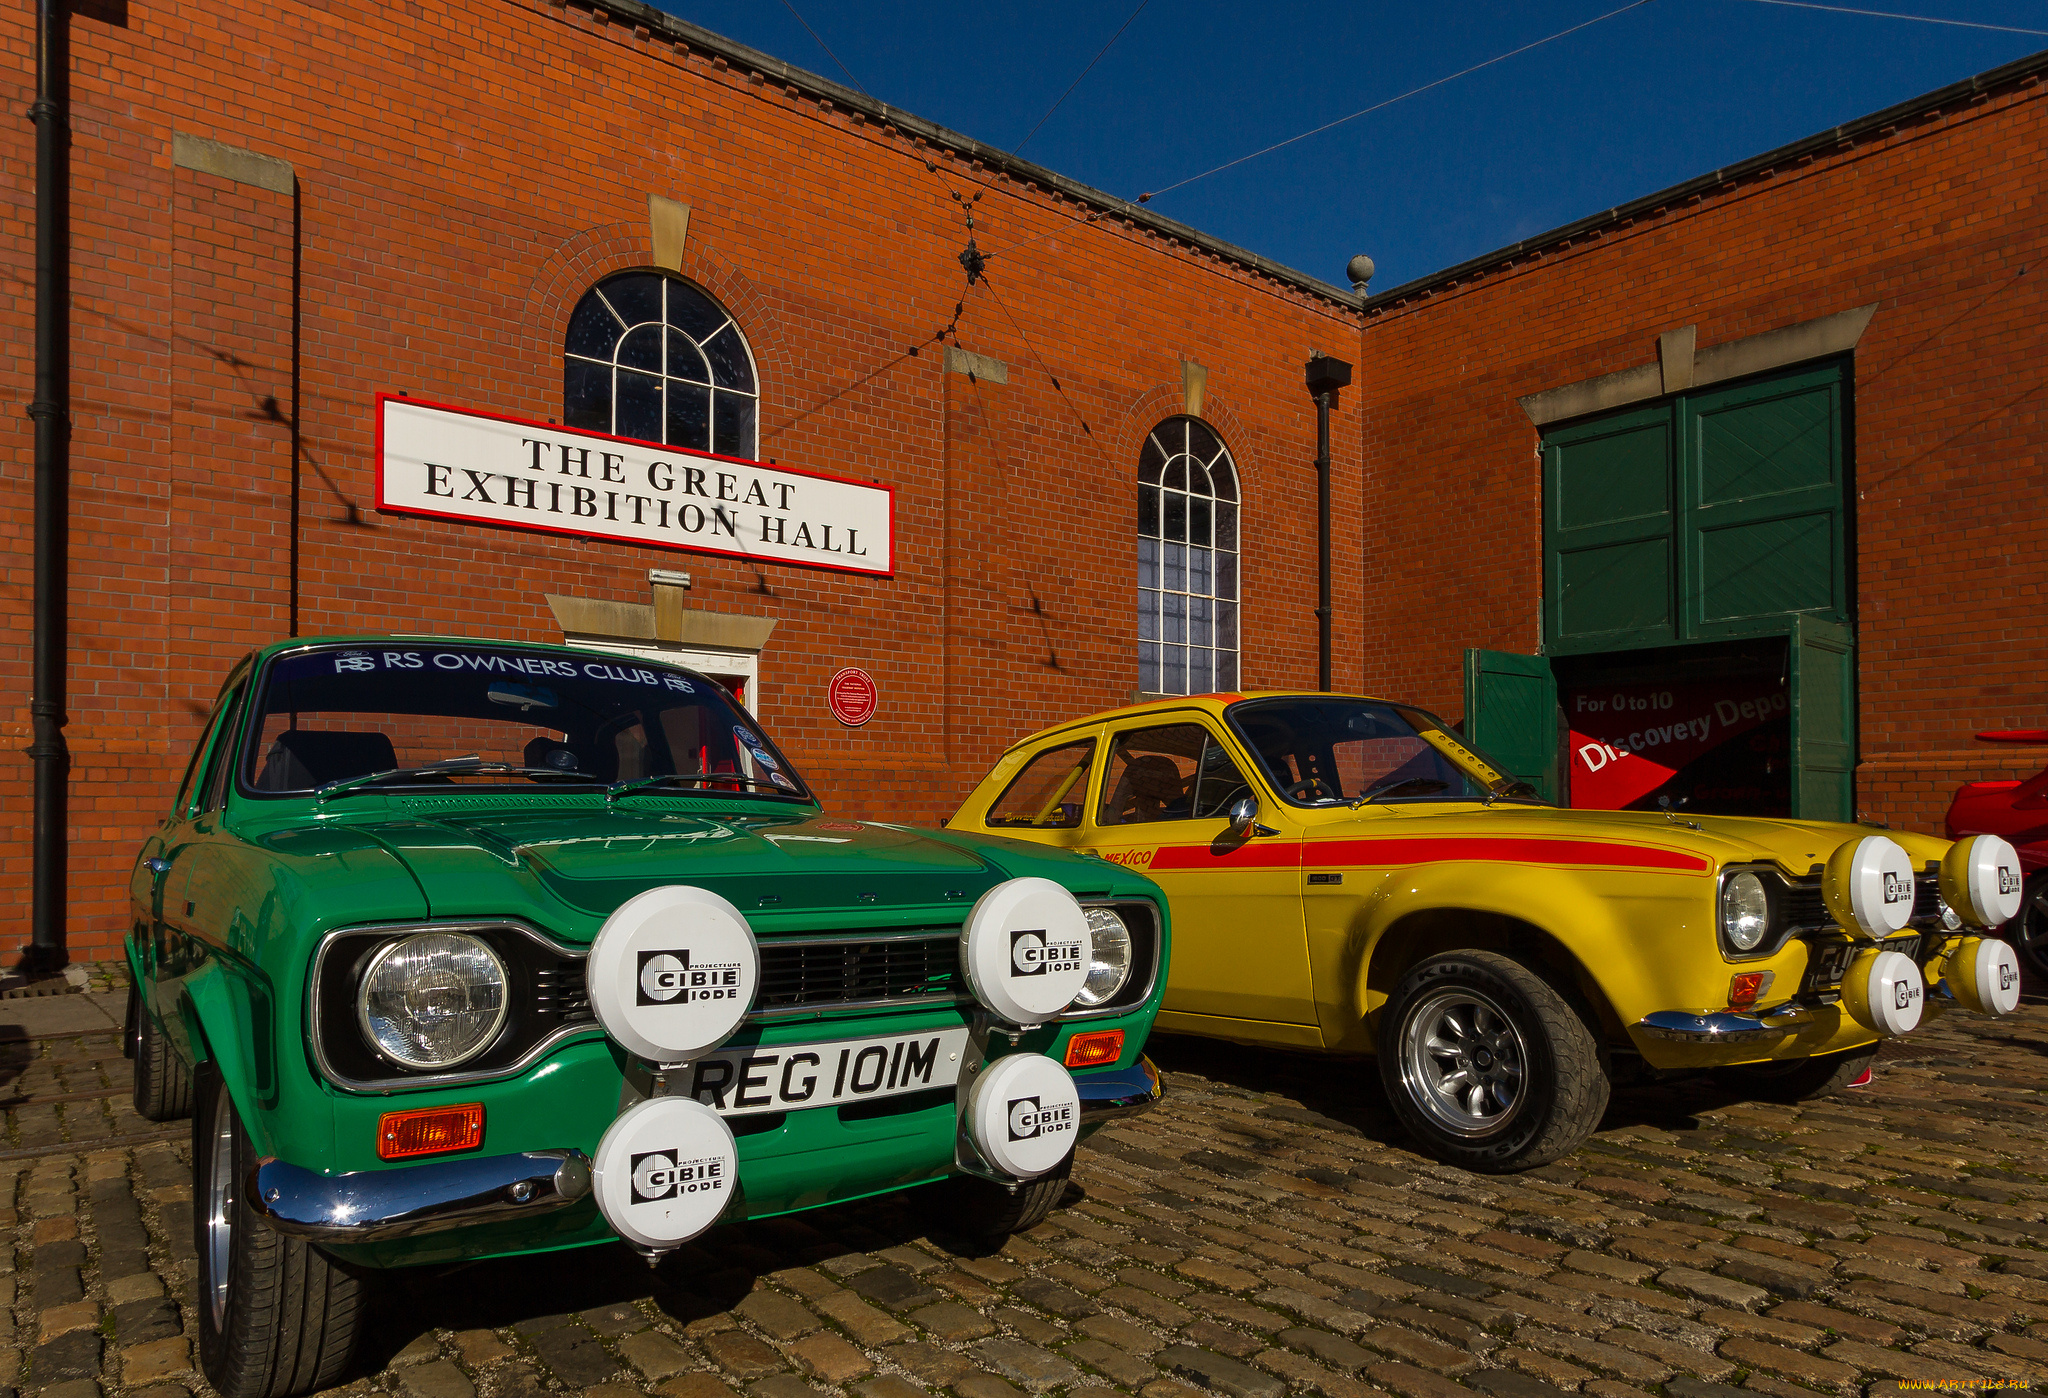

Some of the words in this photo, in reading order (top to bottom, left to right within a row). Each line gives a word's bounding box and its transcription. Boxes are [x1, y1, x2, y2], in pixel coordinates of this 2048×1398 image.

[522, 438, 626, 484] THE
[646, 461, 796, 511] GREAT
[423, 462, 738, 539] EXHIBITION
[759, 514, 868, 557] HALL
[383, 652, 424, 670] RS
[433, 653, 578, 678] OWNERS
[583, 664, 659, 686] CLUB
[1576, 694, 1606, 712] For
[1612, 693, 1625, 711] 0
[1630, 696, 1647, 711] to
[1650, 691, 1674, 711] 10
[1578, 713, 1711, 773] Discovery
[1104, 849, 1151, 866] MEXICO
[1049, 962, 1080, 972] IODE
[691, 988, 737, 1001] IODE
[690, 1052, 821, 1110] REG
[832, 1037, 941, 1098] 101M
[1042, 1122, 1071, 1134] IODE
[678, 1155, 725, 1166] PROJECTEURS
[680, 1180, 722, 1194] IODE
